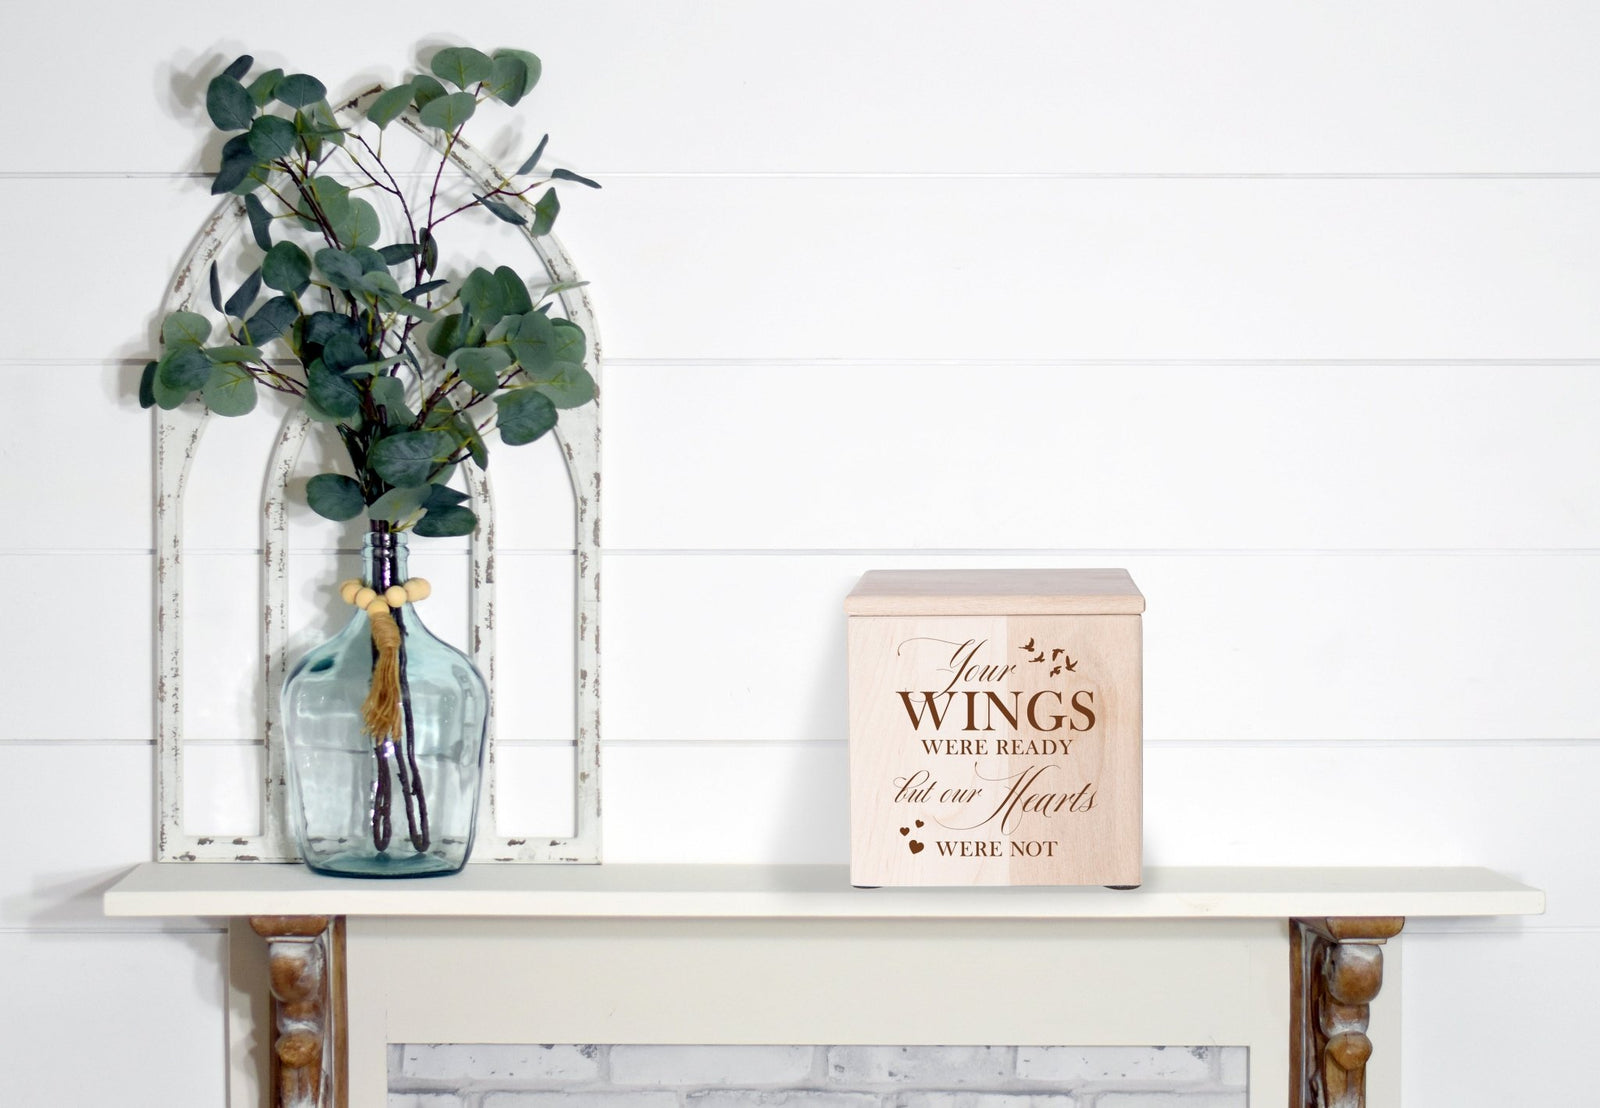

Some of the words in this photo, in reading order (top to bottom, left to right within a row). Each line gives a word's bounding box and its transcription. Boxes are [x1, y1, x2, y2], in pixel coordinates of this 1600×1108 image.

[898, 637, 1016, 702] Your
[896, 690, 1096, 732] WINGS
[921, 739, 988, 755] WERE
[996, 739, 1073, 755] READY
[893, 769, 938, 803] but
[932, 762, 1098, 835] Hearts
[939, 787, 982, 803] our
[936, 841, 1003, 857] WERE
[1011, 841, 1058, 857] NOT
